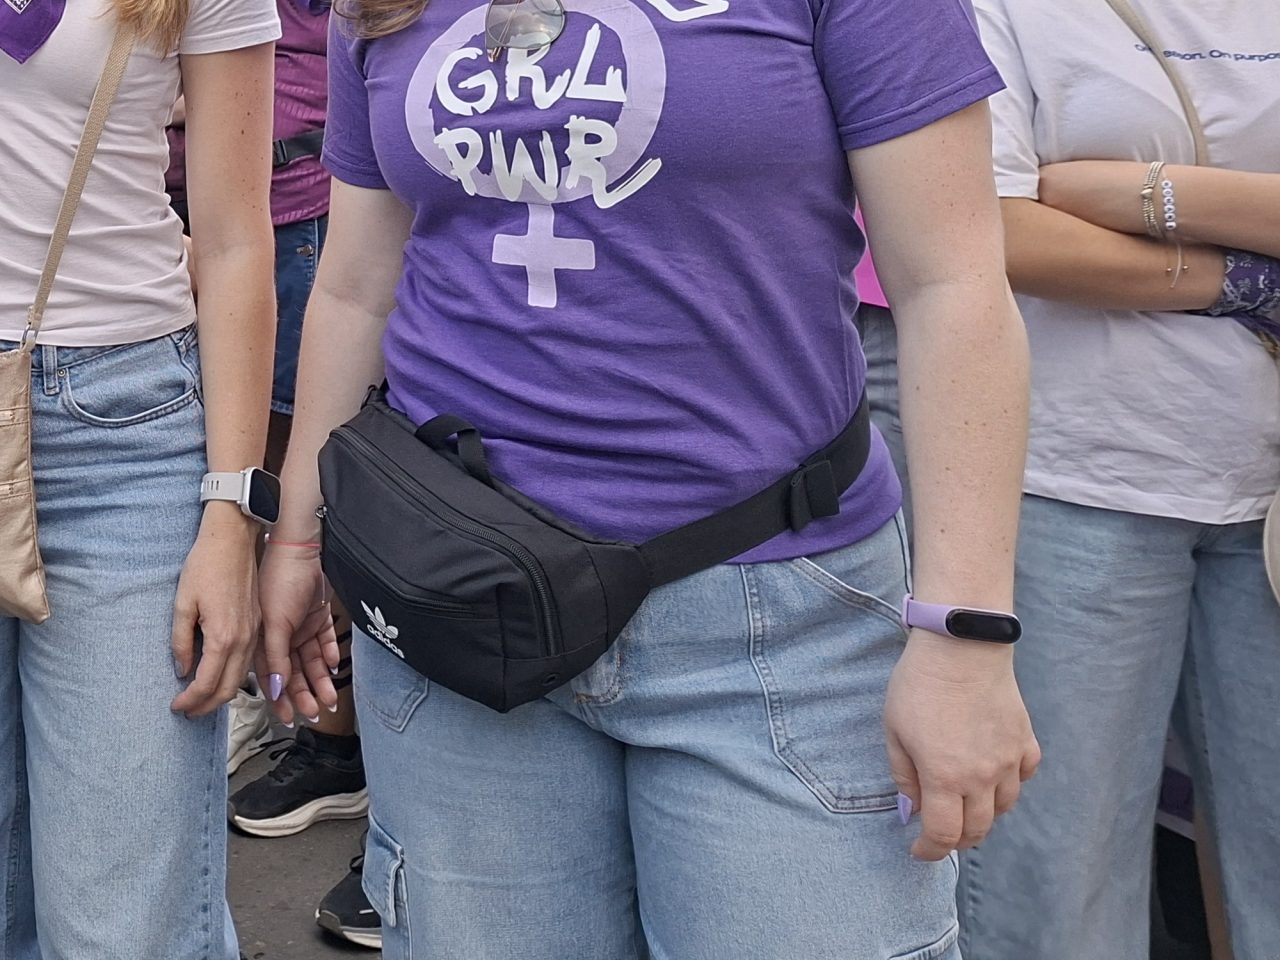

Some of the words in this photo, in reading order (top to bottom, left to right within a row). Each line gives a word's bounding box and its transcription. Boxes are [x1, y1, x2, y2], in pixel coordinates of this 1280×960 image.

[435, 22, 628, 117] GRL
[433, 114, 663, 209] PWR
[366, 623, 406, 659] adidas
